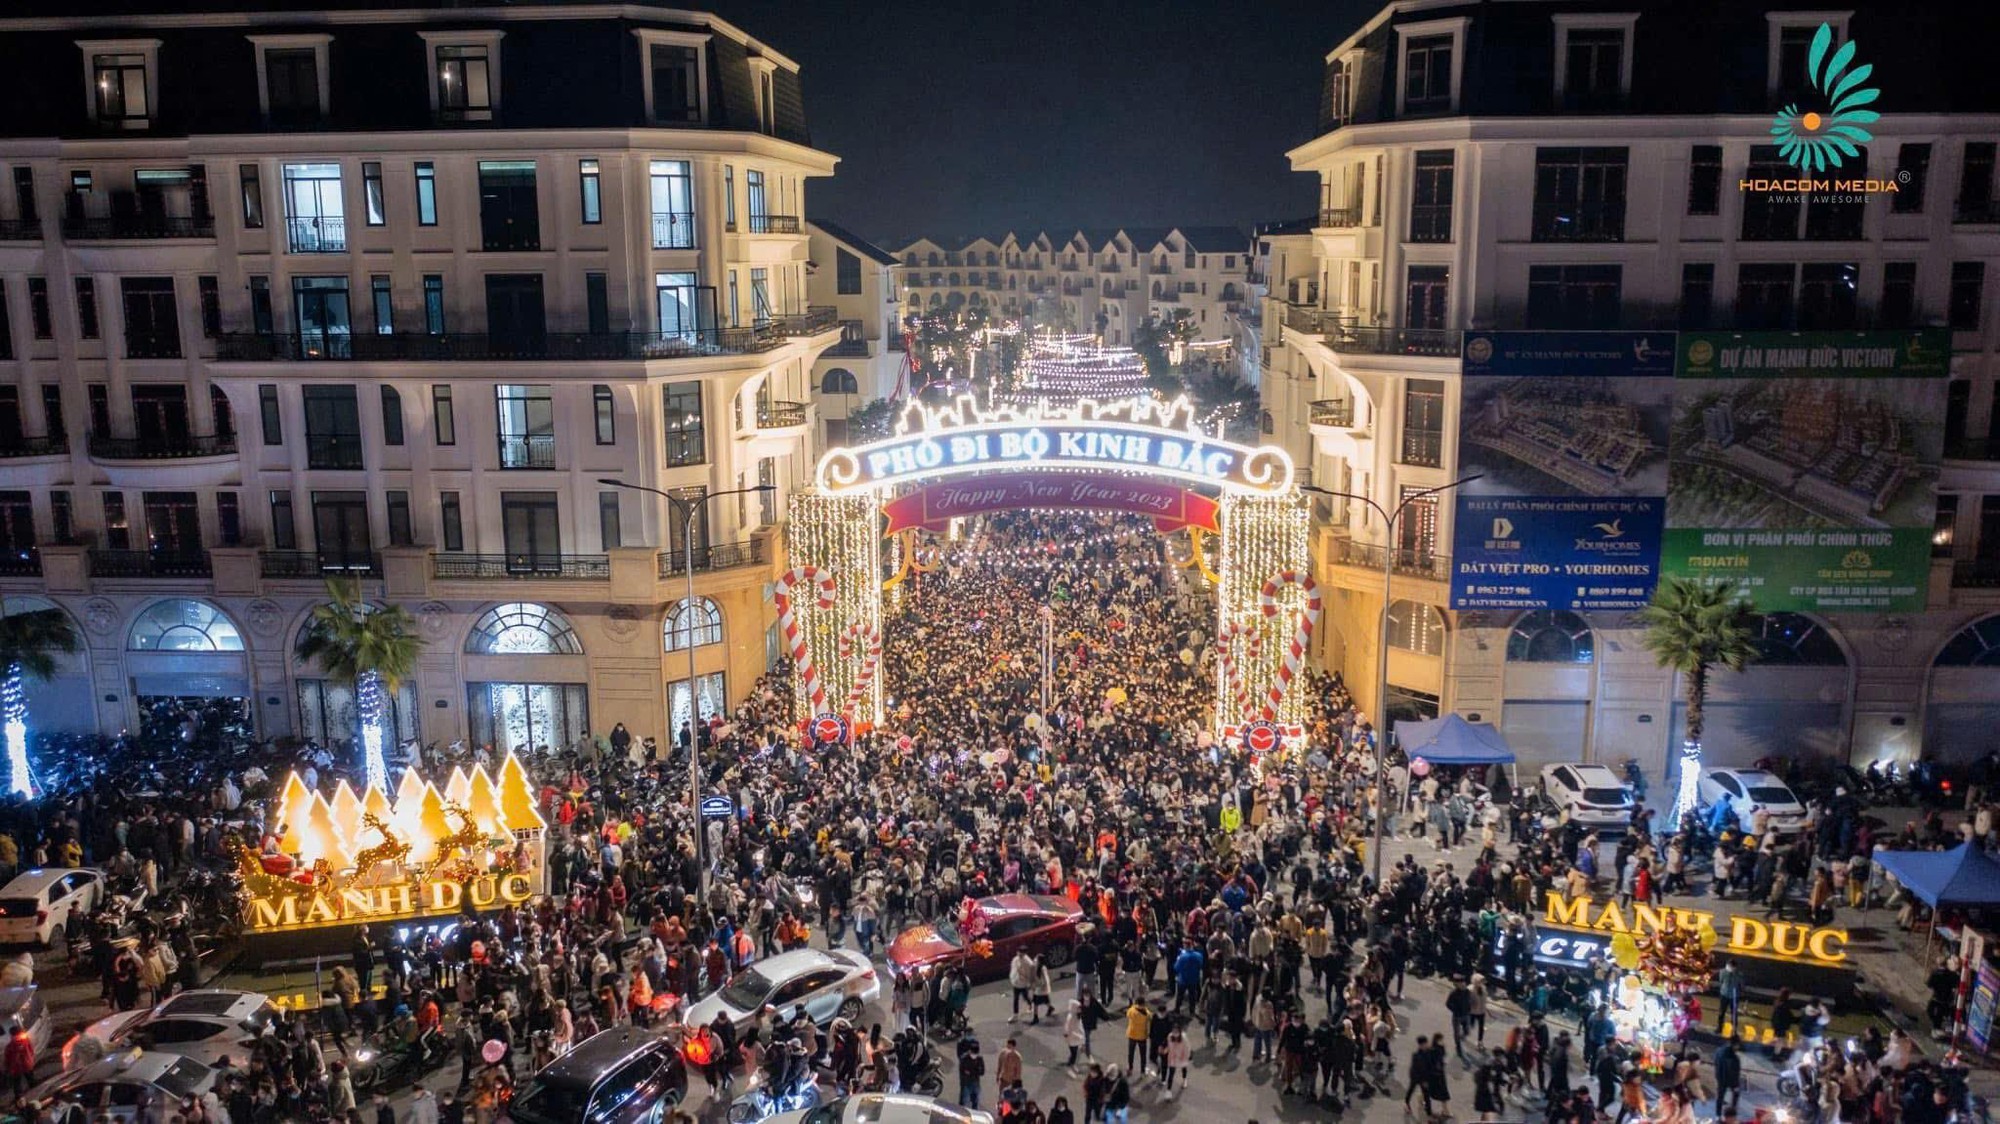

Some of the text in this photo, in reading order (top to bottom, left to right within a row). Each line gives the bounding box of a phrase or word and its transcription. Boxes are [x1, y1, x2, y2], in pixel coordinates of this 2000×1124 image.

[1842, 349, 1897, 368] VICTORY
[868, 429, 1233, 478] PHỐ ĐI BỘ KINH BẮC
[936, 479, 1173, 510] Happy New Year 2023
[1747, 531, 1782, 546] PHÂN
[1786, 531, 1816, 546] PHỐI
[1818, 531, 1857, 546] CHÍNH
[1860, 531, 1893, 546] THỨC
[1461, 560, 1650, 576] ĐẤT VIỆT PRO YOURHOMES
[253, 873, 533, 928] MANH DUC
[1728, 913, 1849, 962] DUC
